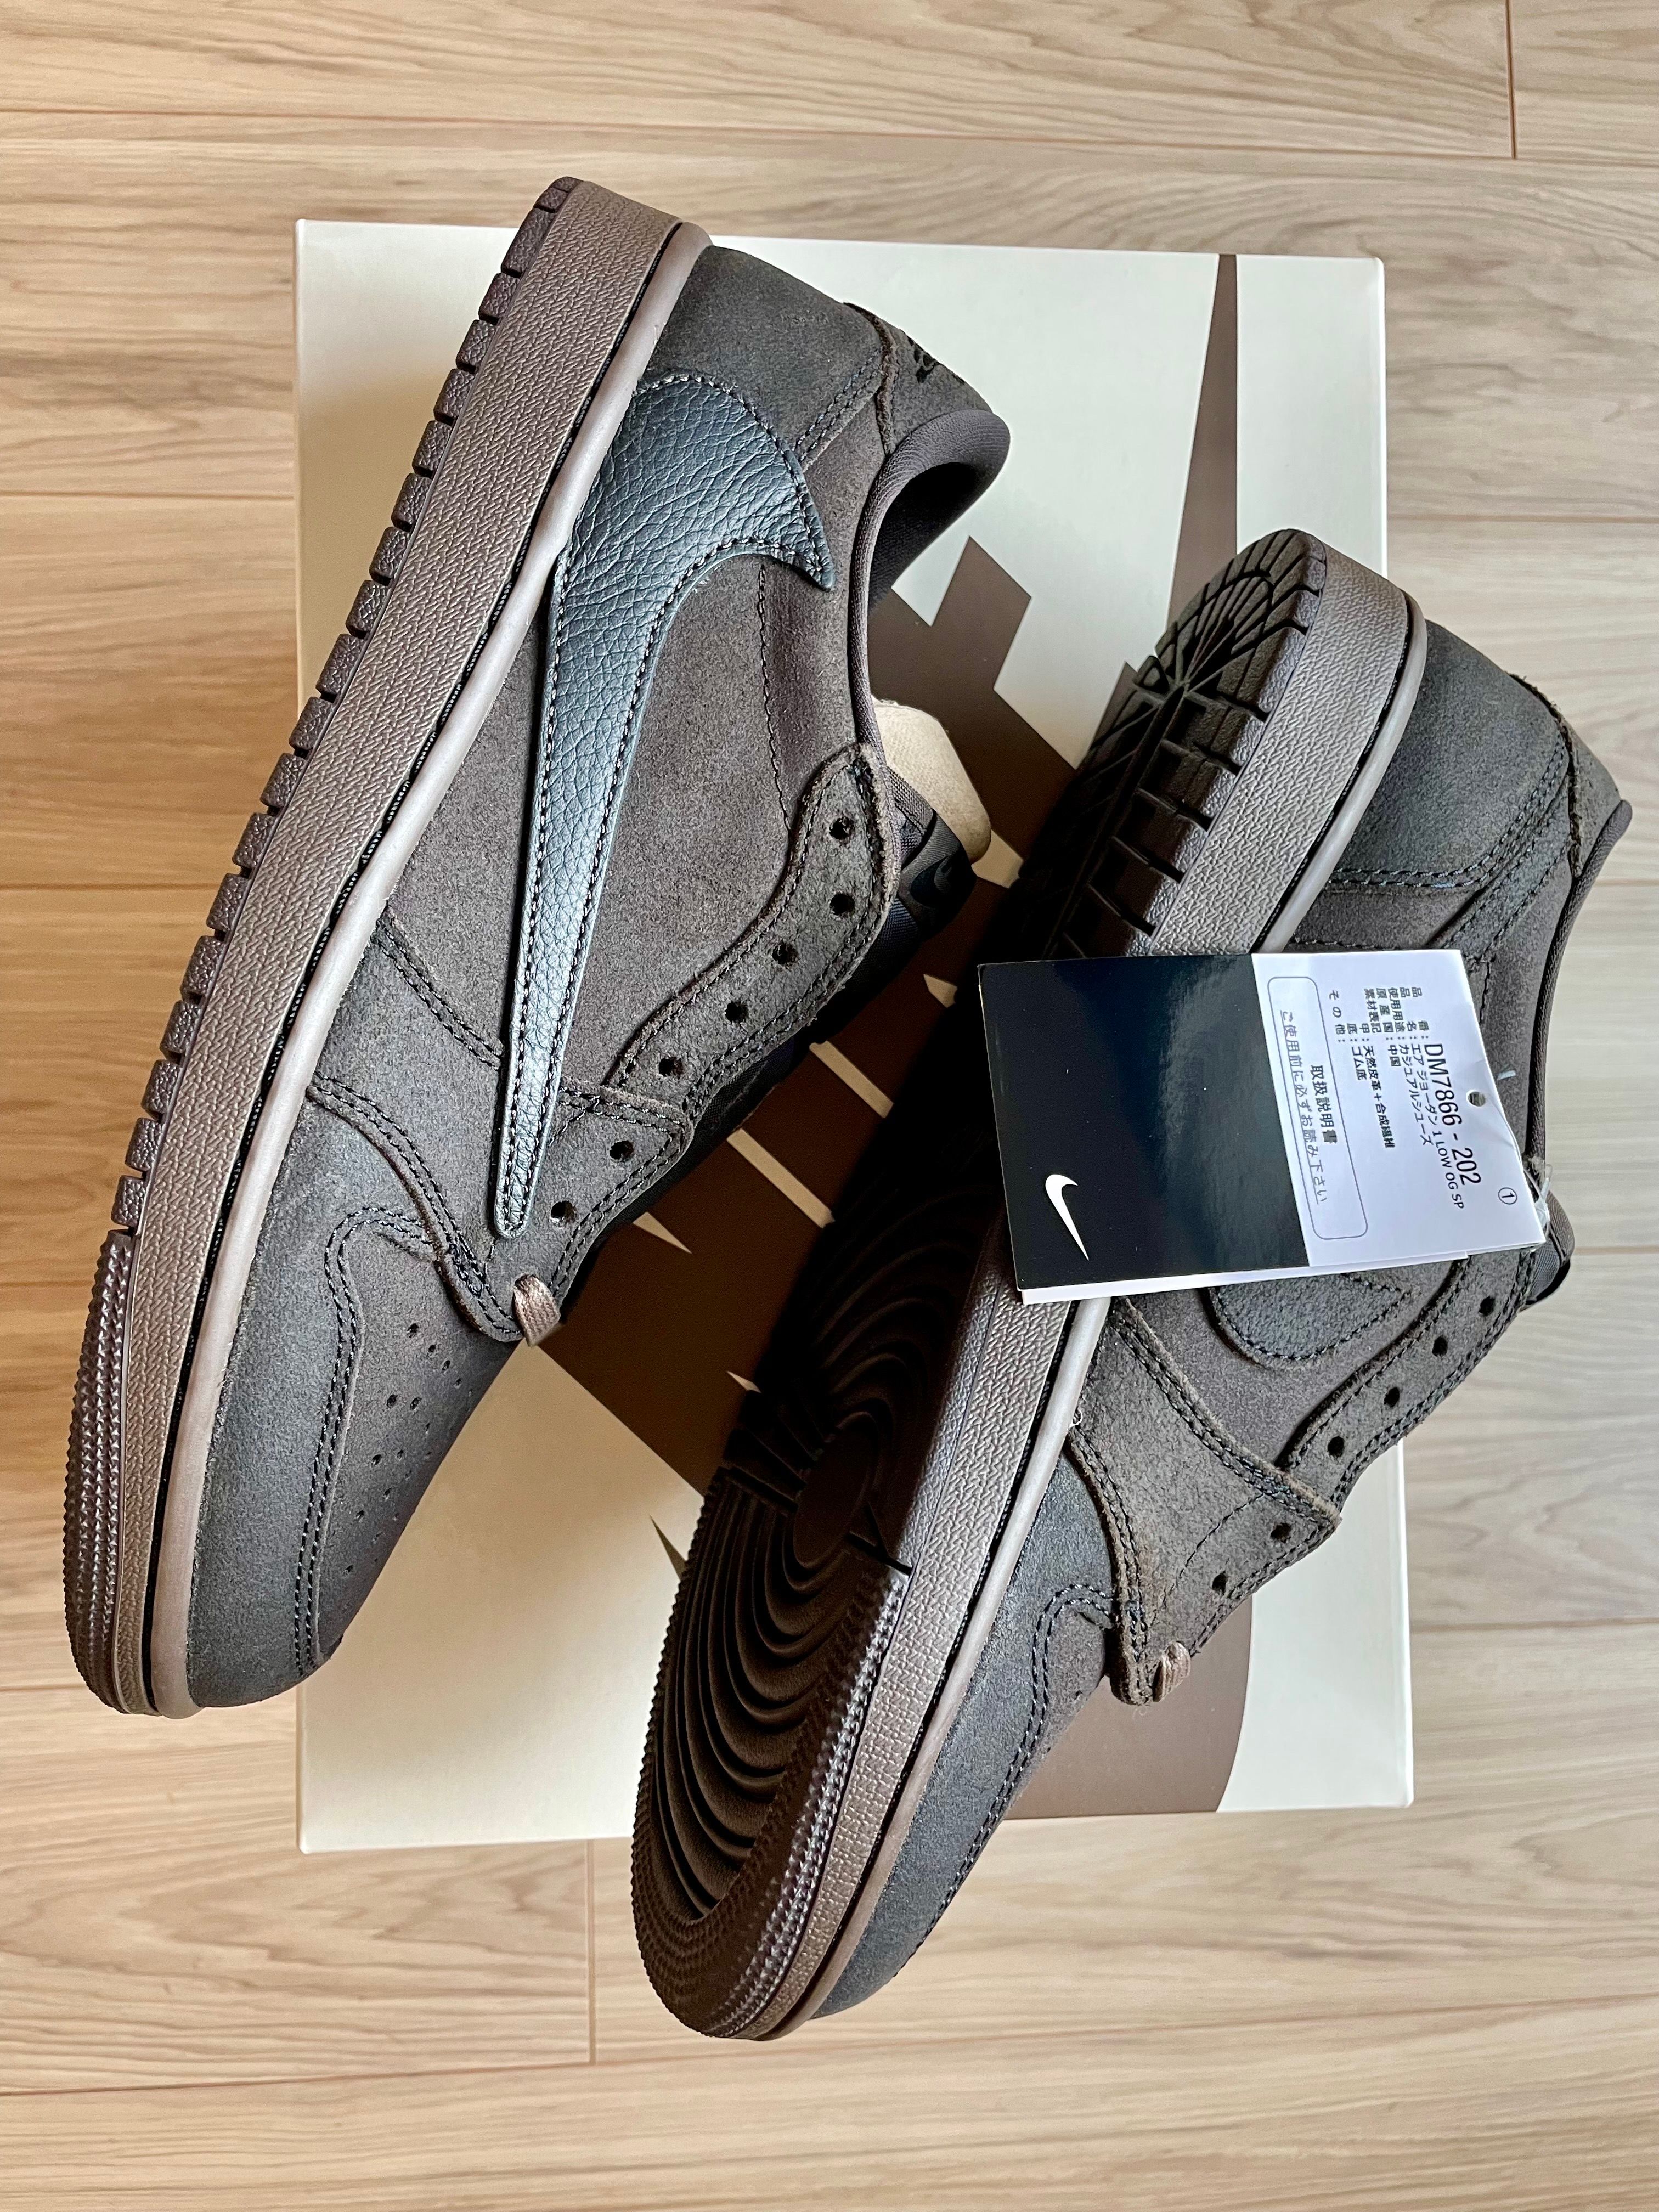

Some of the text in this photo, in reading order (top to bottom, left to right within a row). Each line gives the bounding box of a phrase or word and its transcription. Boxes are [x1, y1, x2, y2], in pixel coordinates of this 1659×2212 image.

[1387, 1045, 1401, 1067] 中国
[1311, 1065, 1338, 1144] 取扱説明書
[1424, 1043, 1462, 1126] DM7866
[1451, 1148, 1481, 1186] 202
[1436, 1141, 1452, 1167] LOW
[1445, 1172, 1458, 1189] OG
[1452, 1194, 1464, 1209] SP
